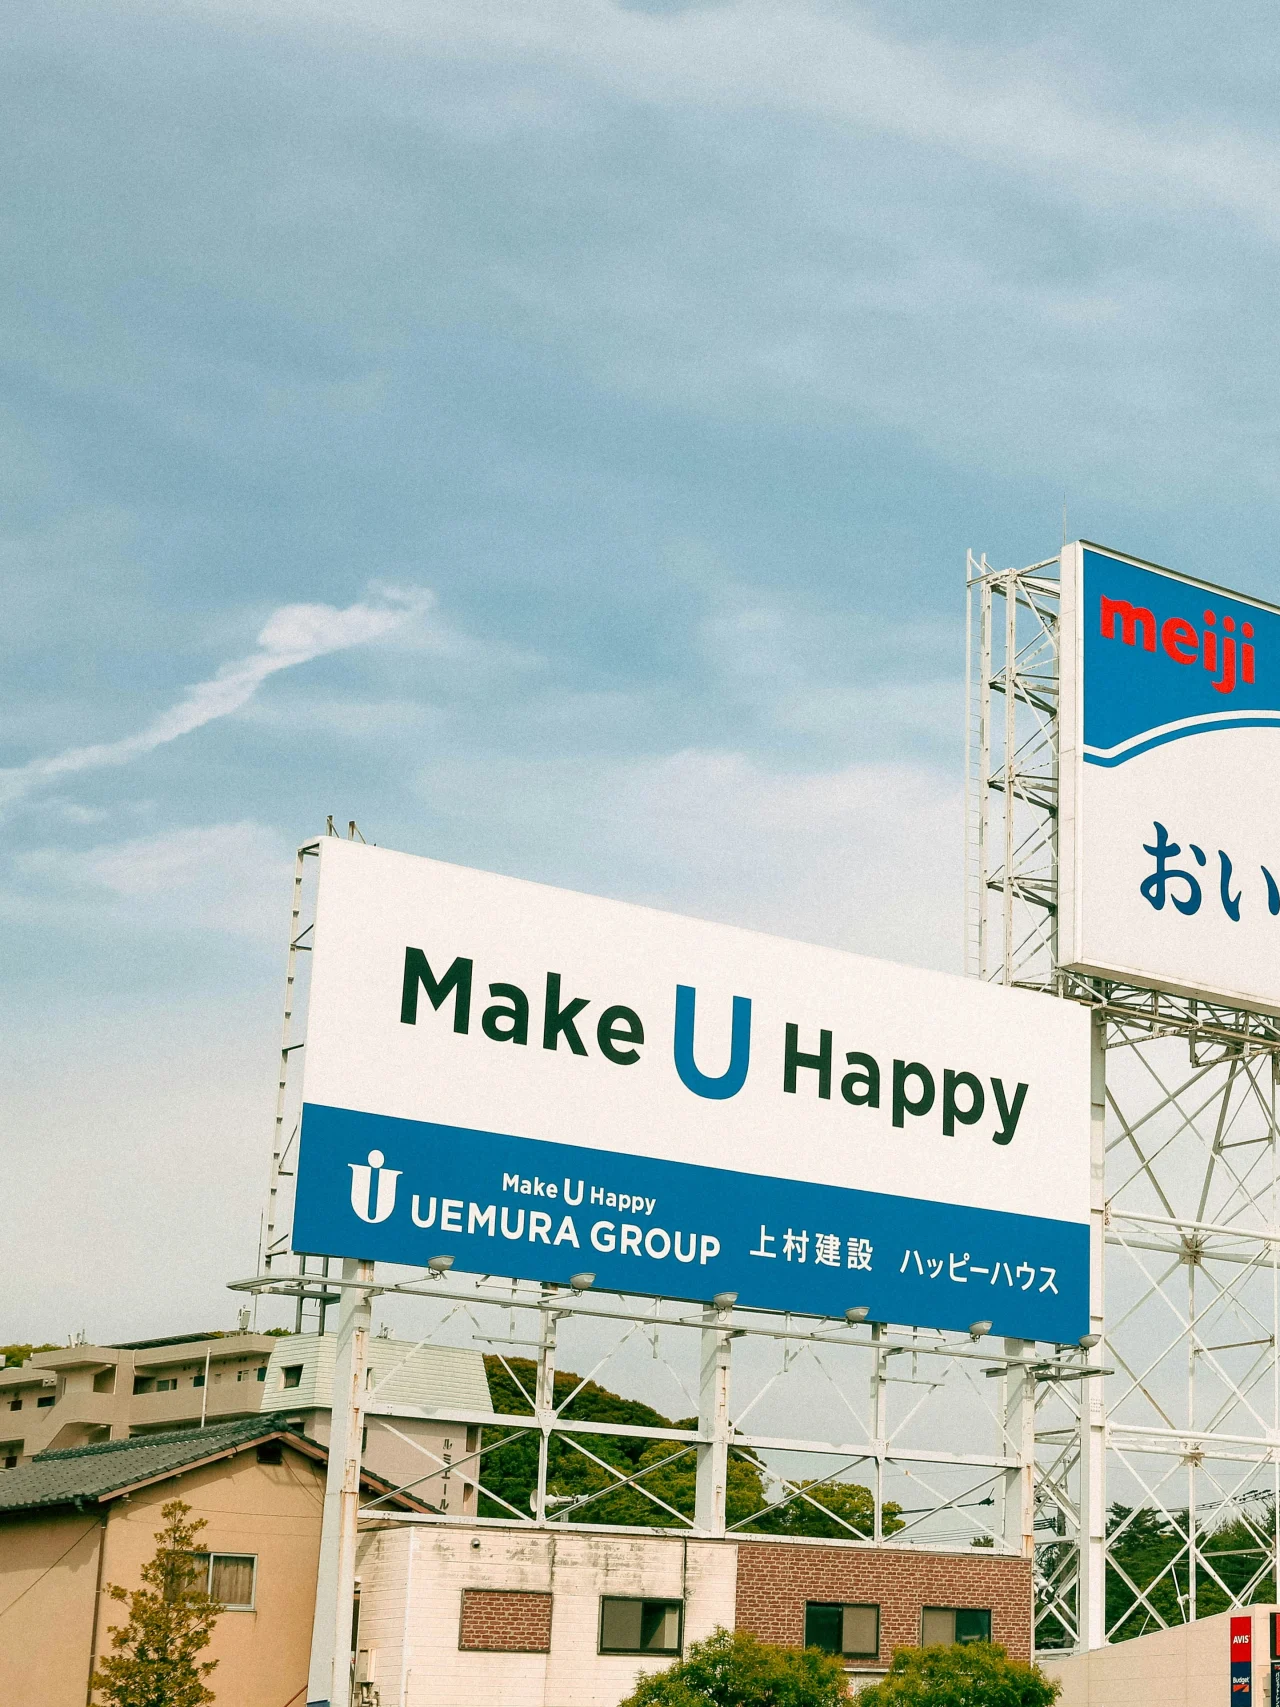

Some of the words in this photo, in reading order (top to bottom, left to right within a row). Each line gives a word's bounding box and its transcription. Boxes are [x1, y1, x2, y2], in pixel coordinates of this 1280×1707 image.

[1100, 594, 1256, 694] meiji
[400, 946, 646, 1066] Make
[673, 984, 752, 1100] U
[783, 1022, 1029, 1146] Happy
[502, 1172, 559, 1199] Make
[563, 1177, 585, 1206] U
[590, 1187, 657, 1215] Happy
[411, 1194, 581, 1248] UEMURA
[590, 1220, 721, 1265] GROUP
[749, 1224, 874, 1271] 上村建設
[900, 1249, 1059, 1295] ハッピーハウス
[1233, 1635, 1249, 1644] AVIS
